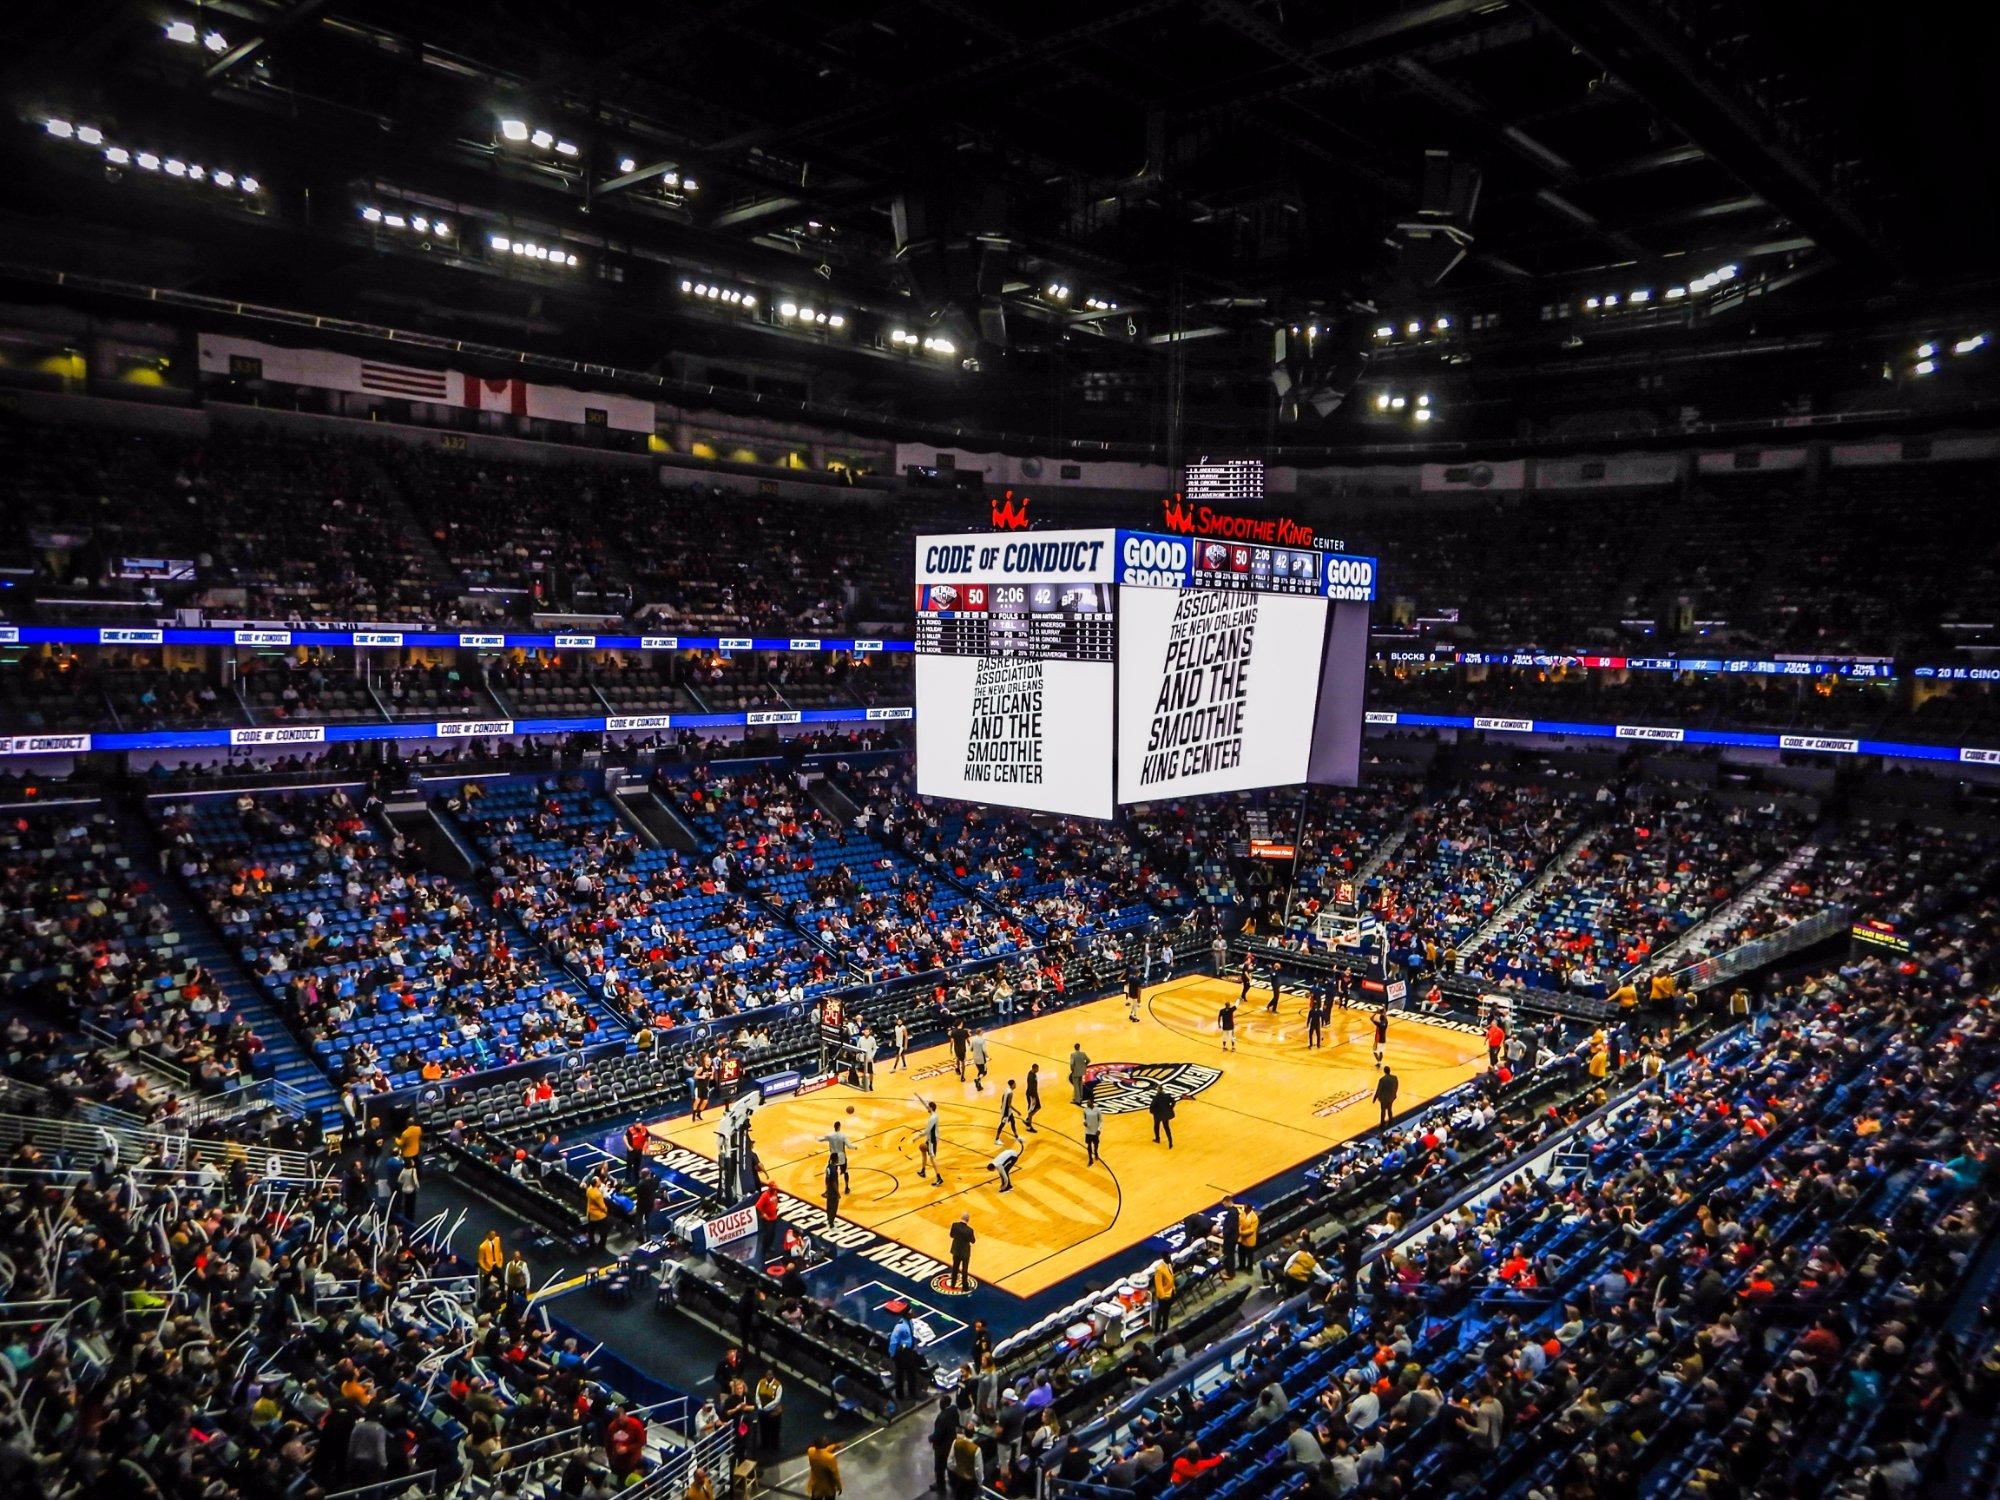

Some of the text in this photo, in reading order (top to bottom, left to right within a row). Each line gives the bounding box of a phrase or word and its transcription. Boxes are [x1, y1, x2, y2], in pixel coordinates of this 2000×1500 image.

[1313, 537, 1344, 551] CENTER
[926, 541, 1104, 573] CODE OF CONDUCT
[1123, 538, 1187, 570] GOOD
[1236, 550, 1247, 565] 50
[1255, 549, 1270, 560] 2:06
[1276, 554, 1287, 568] 42
[1327, 559, 1372, 586] GOOD
[969, 588, 984, 604] 50
[996, 587, 1024, 603] 2:06
[1035, 588, 1051, 604] 42
[1174, 593, 1258, 621] ASSOCIATION
[1170, 608, 1258, 640] THE NEW ORLEANS
[103, 631, 160, 641] CODE CONDUCT
[238, 633, 289, 642] CODE CONDUCT
[355, 635, 400, 643] CODE CONDUCT
[462, 637, 503, 645] CODE CONDUCT
[1164, 626, 1255, 673] PELICANS
[1430, 653, 1435, 662] 0
[1503, 655, 1508, 663] 0
[1600, 659, 1610, 667] 50
[976, 664, 1042, 686] ASSOCIATION
[1816, 665, 1821, 673] 0
[1937, 668, 1951, 678] 20
[1954, 669, 1967, 678] M.
[974, 680, 1043, 697] THE NEW ORLEANS
[1155, 659, 1250, 714] AND THE
[972, 691, 1042, 716] PELICANS
[610, 719, 627, 728] CODE
[637, 718, 667, 728] CONDUCT
[750, 714, 764, 722] CODE
[773, 713, 798, 722] CONDUCT
[1477, 720, 1529, 729] CODE CONDUCT
[441, 725, 461, 734] CODE
[473, 723, 509, 733] CONDUCT
[970, 713, 1042, 740] AND THE
[1148, 701, 1246, 751] SMOOTHIE
[1620, 728, 1638, 737] CODE
[1647, 729, 1680, 738] CONDUCT
[237, 731, 261, 741] CODE
[276, 729, 320, 740] CONDUCT
[29, 737, 84, 750] CONDUCT
[227, 744, 252, 757] 123
[967, 740, 1042, 762] SMOOTHIE
[1783, 738, 1804, 747] CODE
[1816, 740, 1853, 750] CONDUCT
[1141, 738, 1241, 786] KING CENTER
[1964, 751, 1986, 760] CODE
[964, 764, 1042, 784] KING CENTER
[824, 1010, 838, 1025] 24
[1386, 1008, 1487, 1036] PELICANS
[708, 1209, 753, 1238] ROUSES
[719, 1228, 746, 1243] MARKETS
[857, 1242, 948, 1282] NEW
